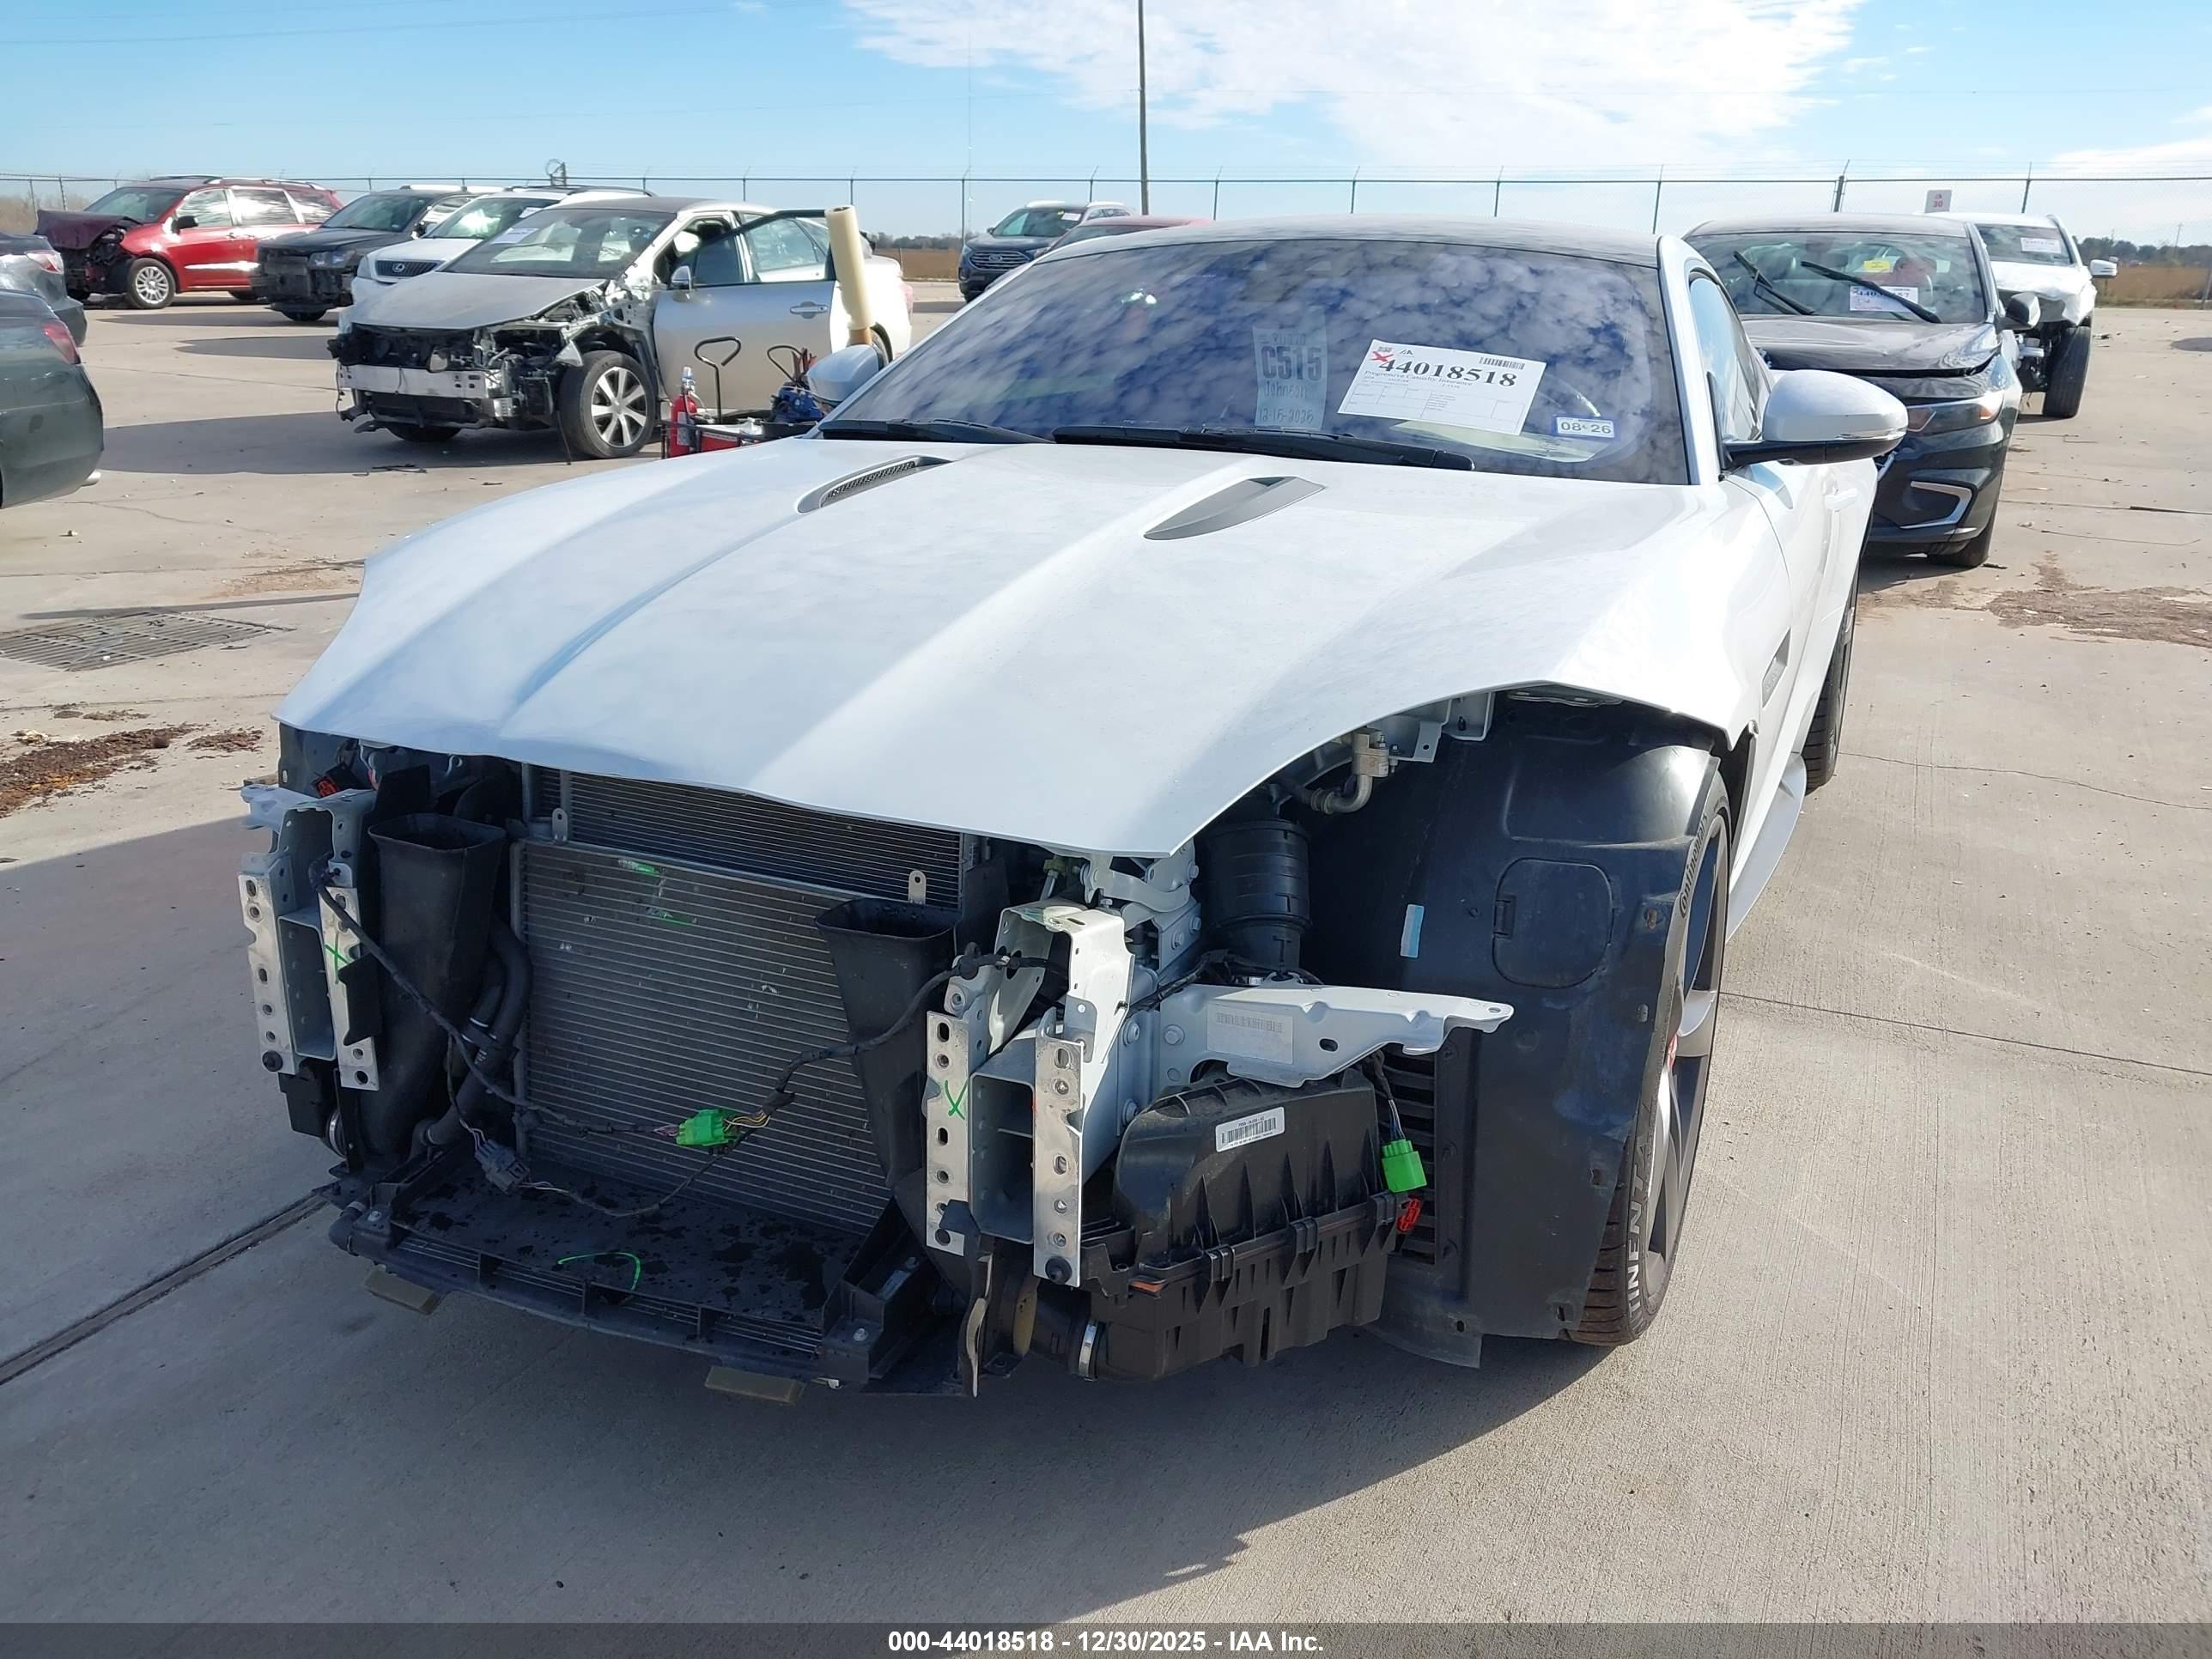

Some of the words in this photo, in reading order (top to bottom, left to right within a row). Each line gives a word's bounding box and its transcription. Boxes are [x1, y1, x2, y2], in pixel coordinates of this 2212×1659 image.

[1261, 345, 1322, 381] C515
[1379, 359, 1518, 387] 44018518
[1560, 422, 1582, 431] 08
[1590, 424, 1612, 434] 26
[1679, 819, 1706, 919] Continental
